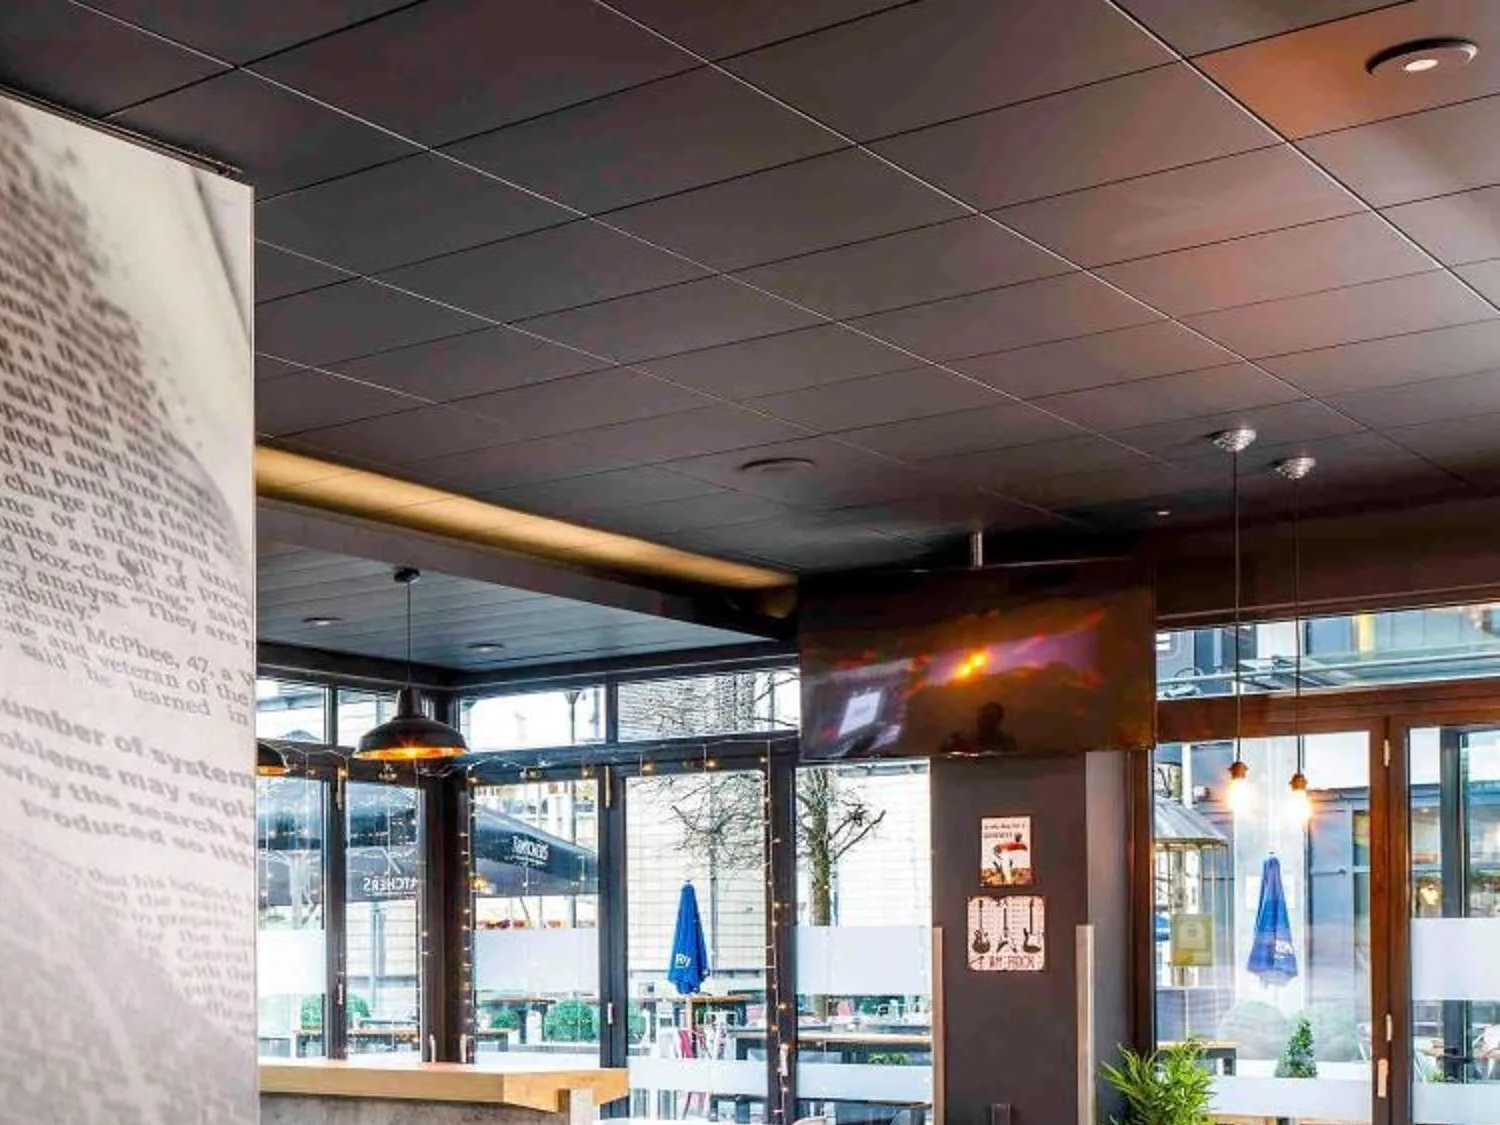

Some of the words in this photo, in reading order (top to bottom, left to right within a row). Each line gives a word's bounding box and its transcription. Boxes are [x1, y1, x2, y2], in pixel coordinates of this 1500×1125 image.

[17, 449, 46, 478] in
[51, 469, 138, 518] putting
[64, 450, 109, 480] and
[4, 471, 88, 515] charge
[50, 510, 78, 532] or
[91, 517, 184, 574] infantry
[68, 537, 106, 561] are
[165, 574, 188, 591] of
[47, 633, 92, 661] and
[96, 653, 181, 691] veteran
[185, 676, 210, 696] of
[215, 683, 251, 708] the
[84, 623, 181, 670] McPhee,
[128, 679, 213, 717] learned
[227, 704, 250, 728] in
[113, 734, 144, 757] of
[67, 782, 124, 810] the
[128, 800, 227, 837] search
[117, 769, 180, 804] may
[19, 797, 168, 847] produced
[171, 835, 206, 854] so
